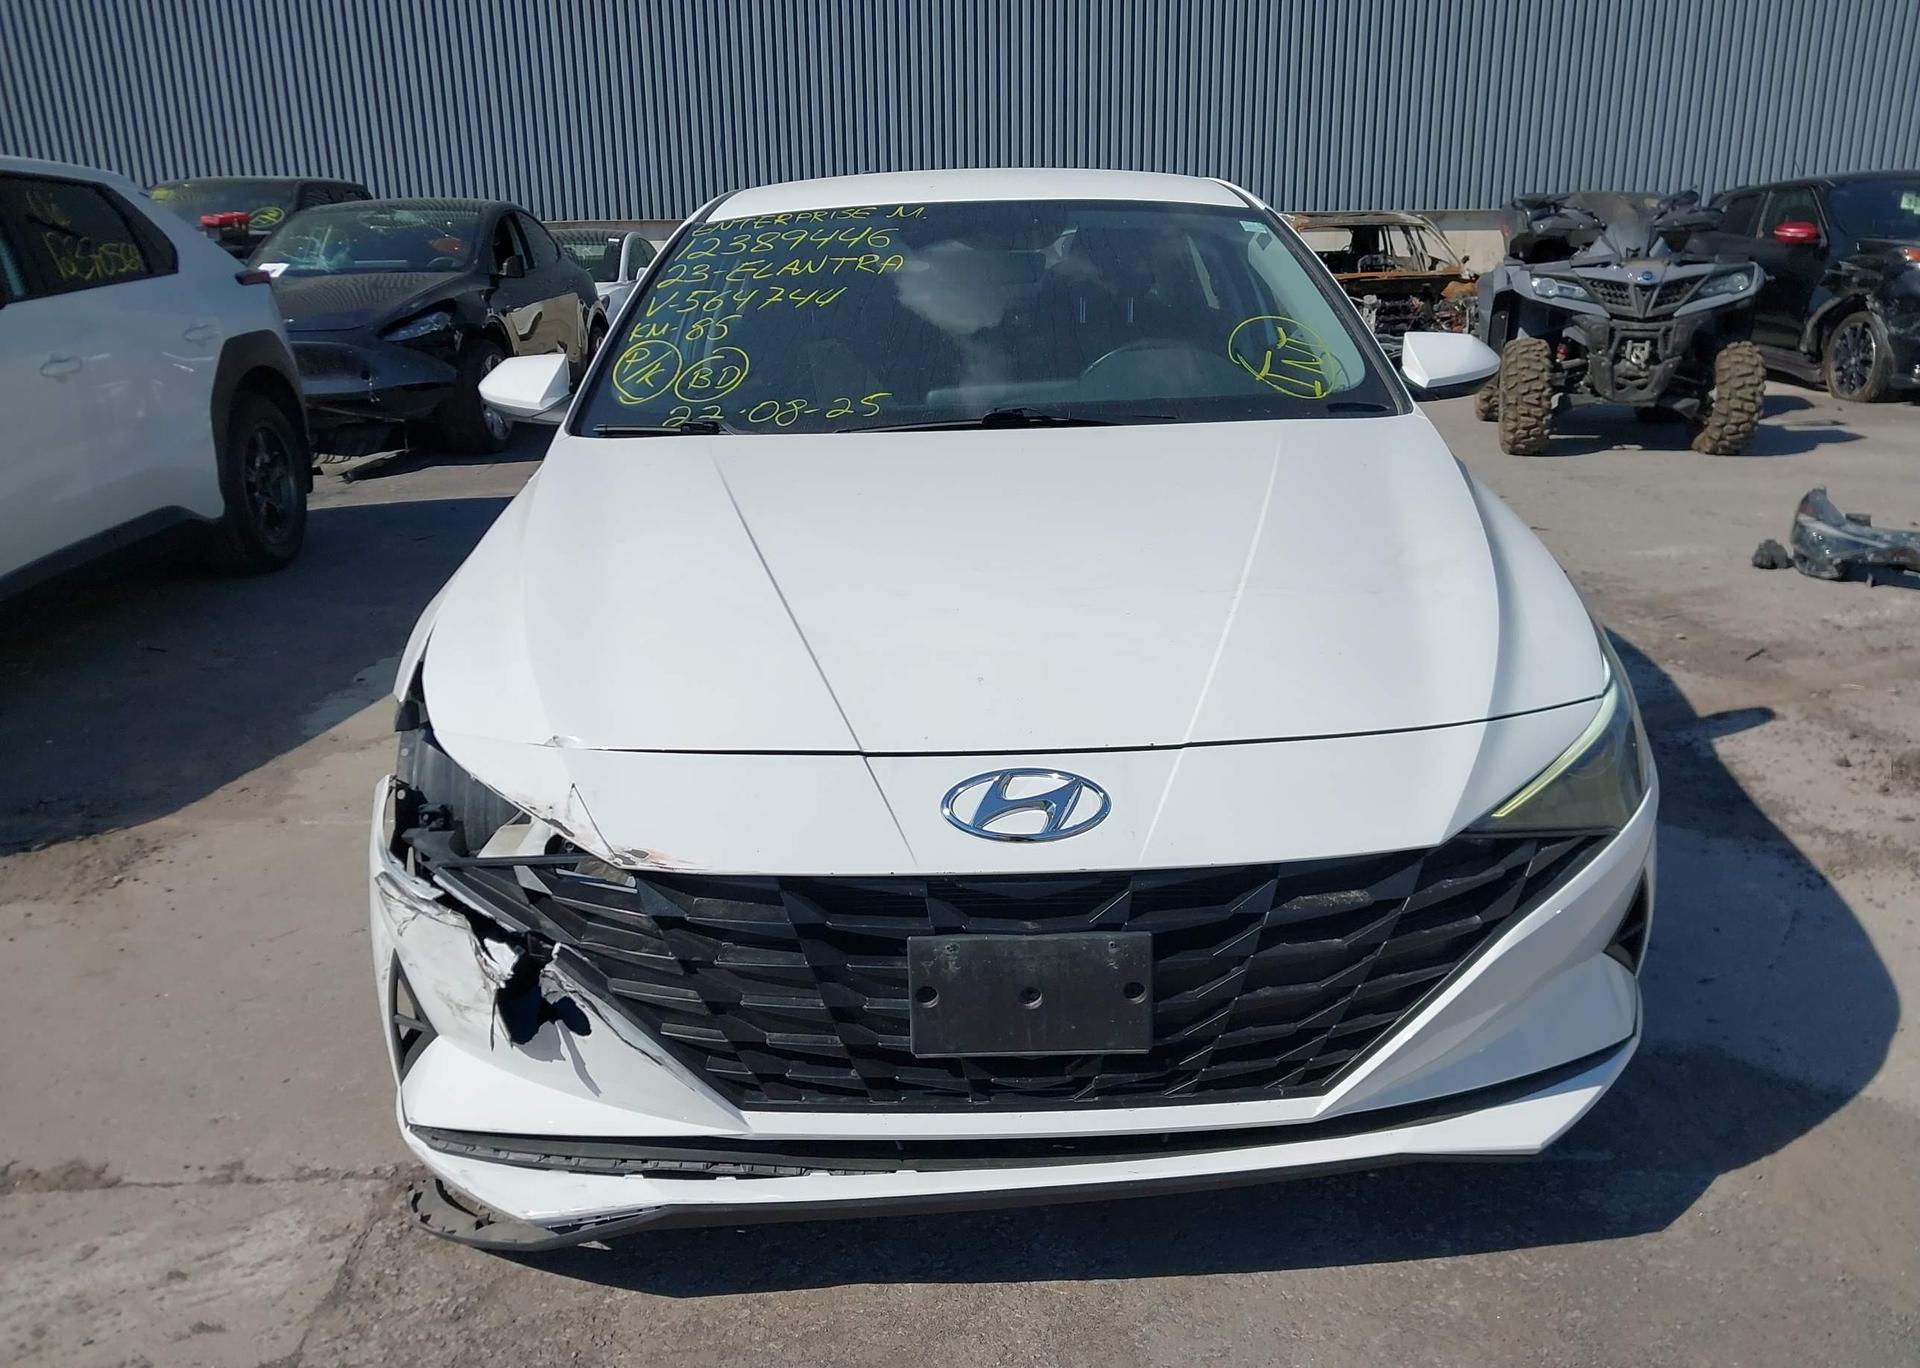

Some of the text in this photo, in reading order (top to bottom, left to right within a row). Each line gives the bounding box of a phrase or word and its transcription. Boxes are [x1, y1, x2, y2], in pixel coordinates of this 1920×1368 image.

[692, 206, 878, 236] ENTERPRISE
[674, 227, 900, 262] 12389446
[657, 254, 905, 288] 23-ELANTRA
